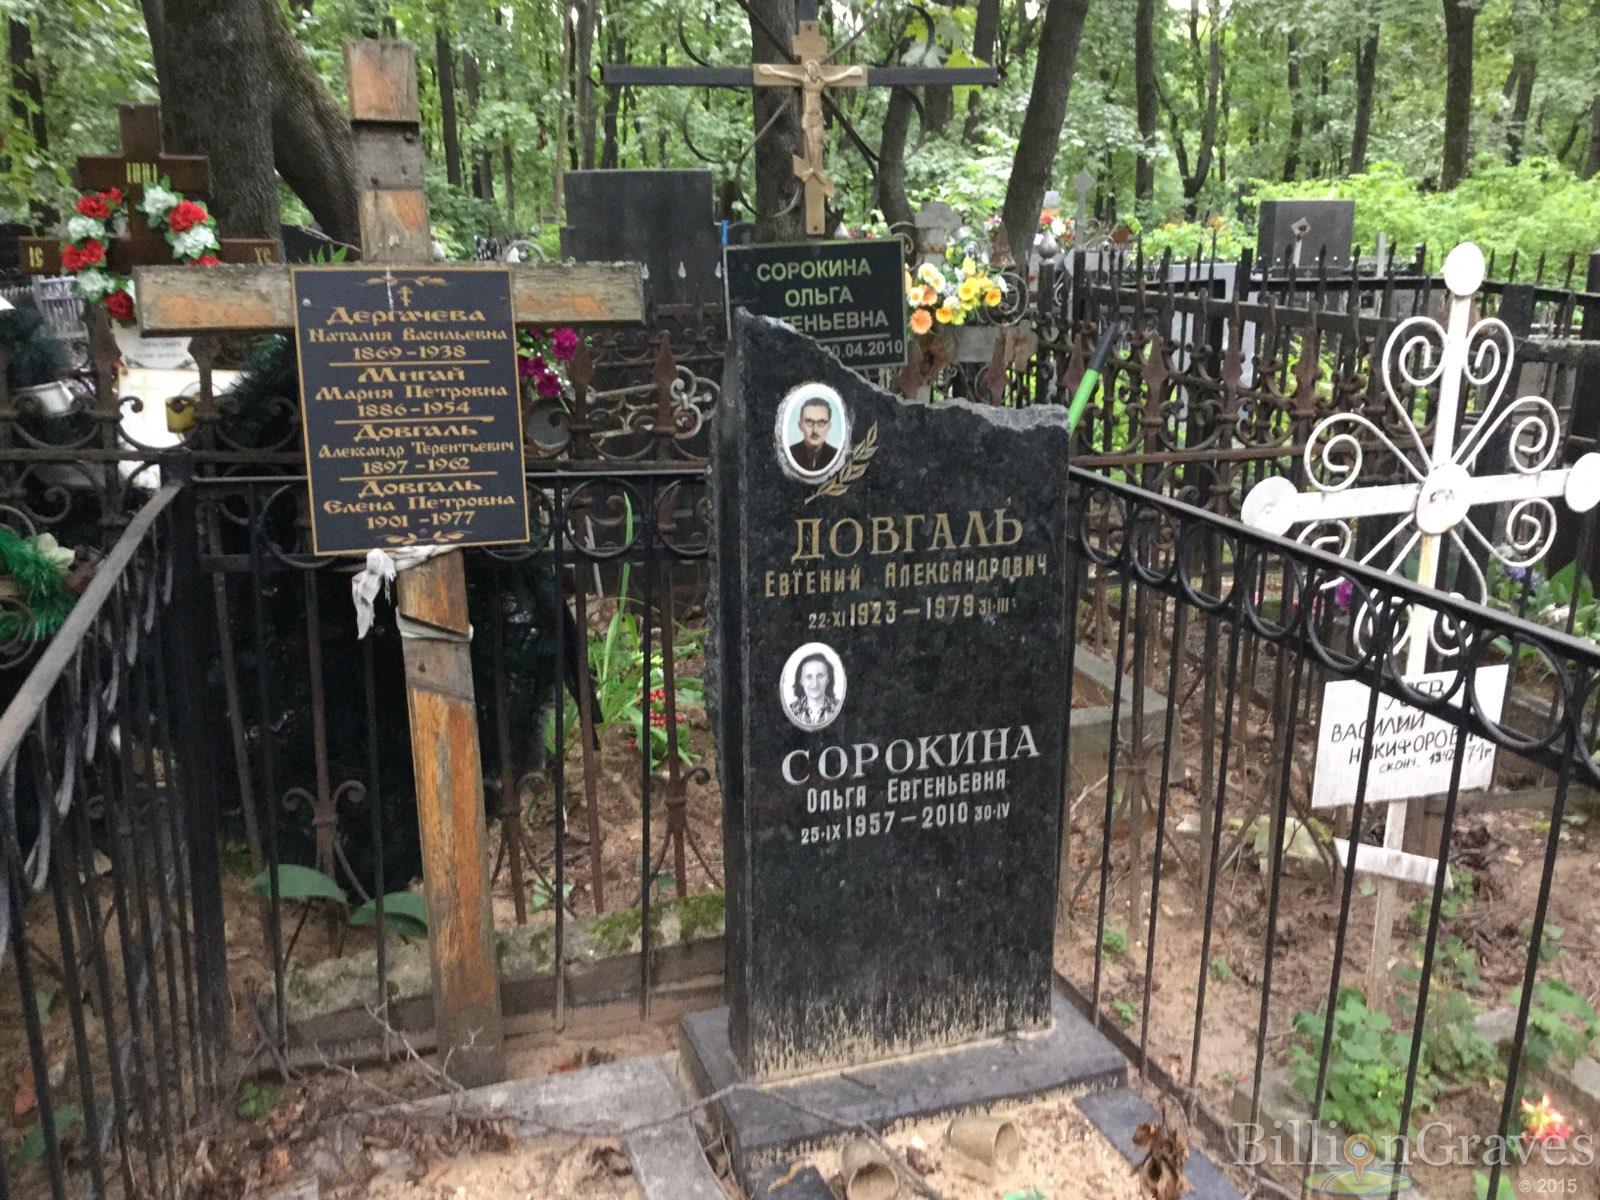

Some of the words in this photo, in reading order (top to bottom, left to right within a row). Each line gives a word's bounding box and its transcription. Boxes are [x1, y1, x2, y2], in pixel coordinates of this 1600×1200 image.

[757, 258, 872, 282] СОРОКИНА
[784, 286, 853, 307] ОЛЬГА
[326, 306, 486, 326] Дергачева
[781, 309, 889, 333] ЕНЬЕВНА
[308, 328, 393, 343] Наталия
[402, 327, 508, 341] Васильевна
[827, 339, 903, 359] 0.04.2010
[357, 367, 465, 383] Мигай
[315, 386, 393, 402] Мария
[404, 384, 508, 401] Петровна
[353, 424, 478, 441] Довгаль
[318, 444, 404, 459] Александр
[411, 441, 514, 456] Терентьевич
[358, 480, 482, 498] Довгаль
[408, 495, 516, 510] Петровна
[791, 508, 1024, 564] ДОВГАЛЬ
[765, 564, 861, 597] ЕВГЕНИЙ
[885, 554, 1047, 588] АЛЕКСАНДРОВИЧ
[782, 725, 1041, 785] СОРОКИНА
[807, 785, 866, 813] ОЛЬГА
[887, 768, 1006, 803] ЕВГЕНЬЕВНА
